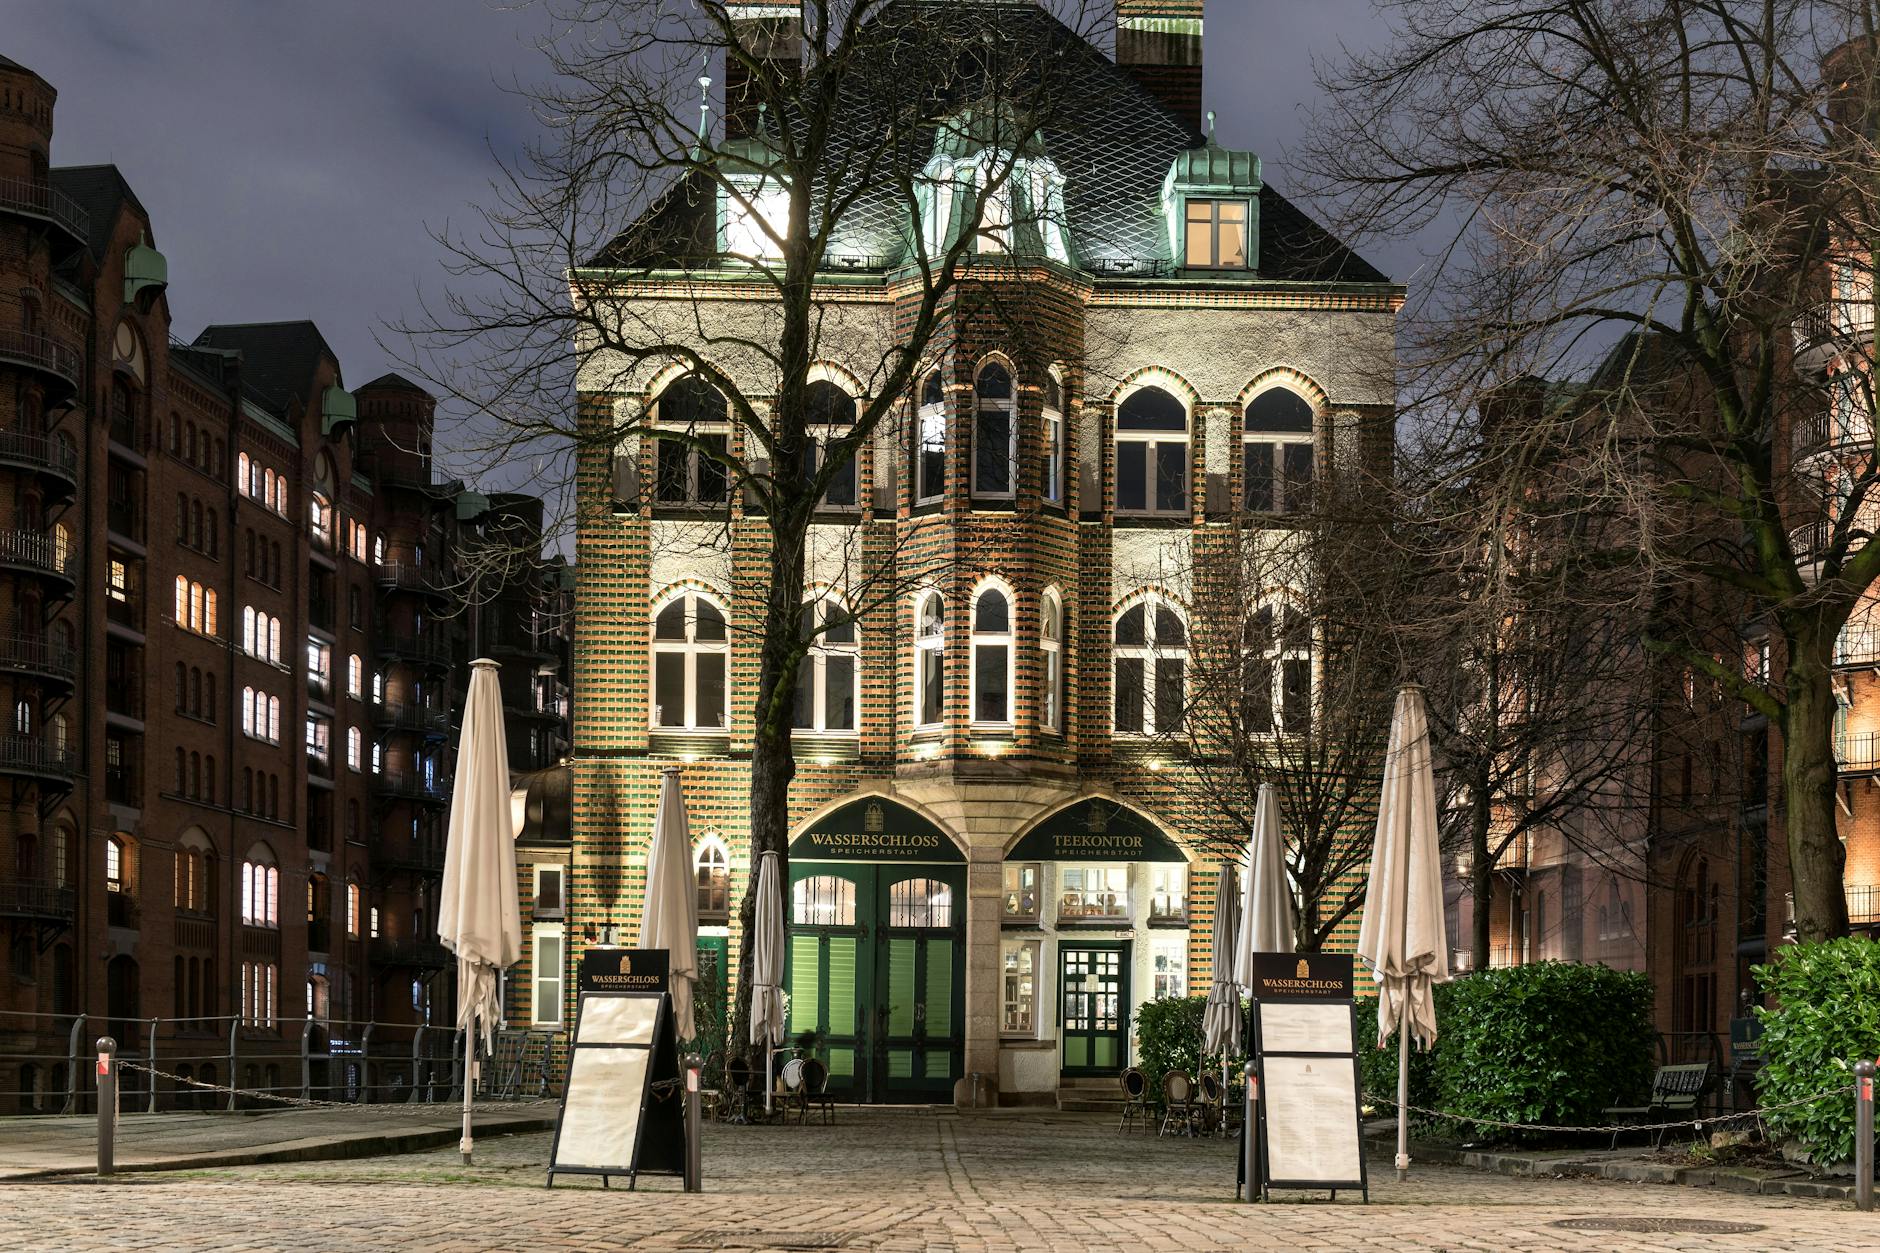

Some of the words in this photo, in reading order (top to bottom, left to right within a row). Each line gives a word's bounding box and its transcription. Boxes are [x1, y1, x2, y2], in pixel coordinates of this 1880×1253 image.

[811, 833, 939, 847] WASSERSCHLOSS
[1052, 835, 1143, 847] TEEKONTOR
[592, 975, 660, 984] WASSERSCHLOSS
[1262, 978, 1343, 989] WASSERSCHLOSS
